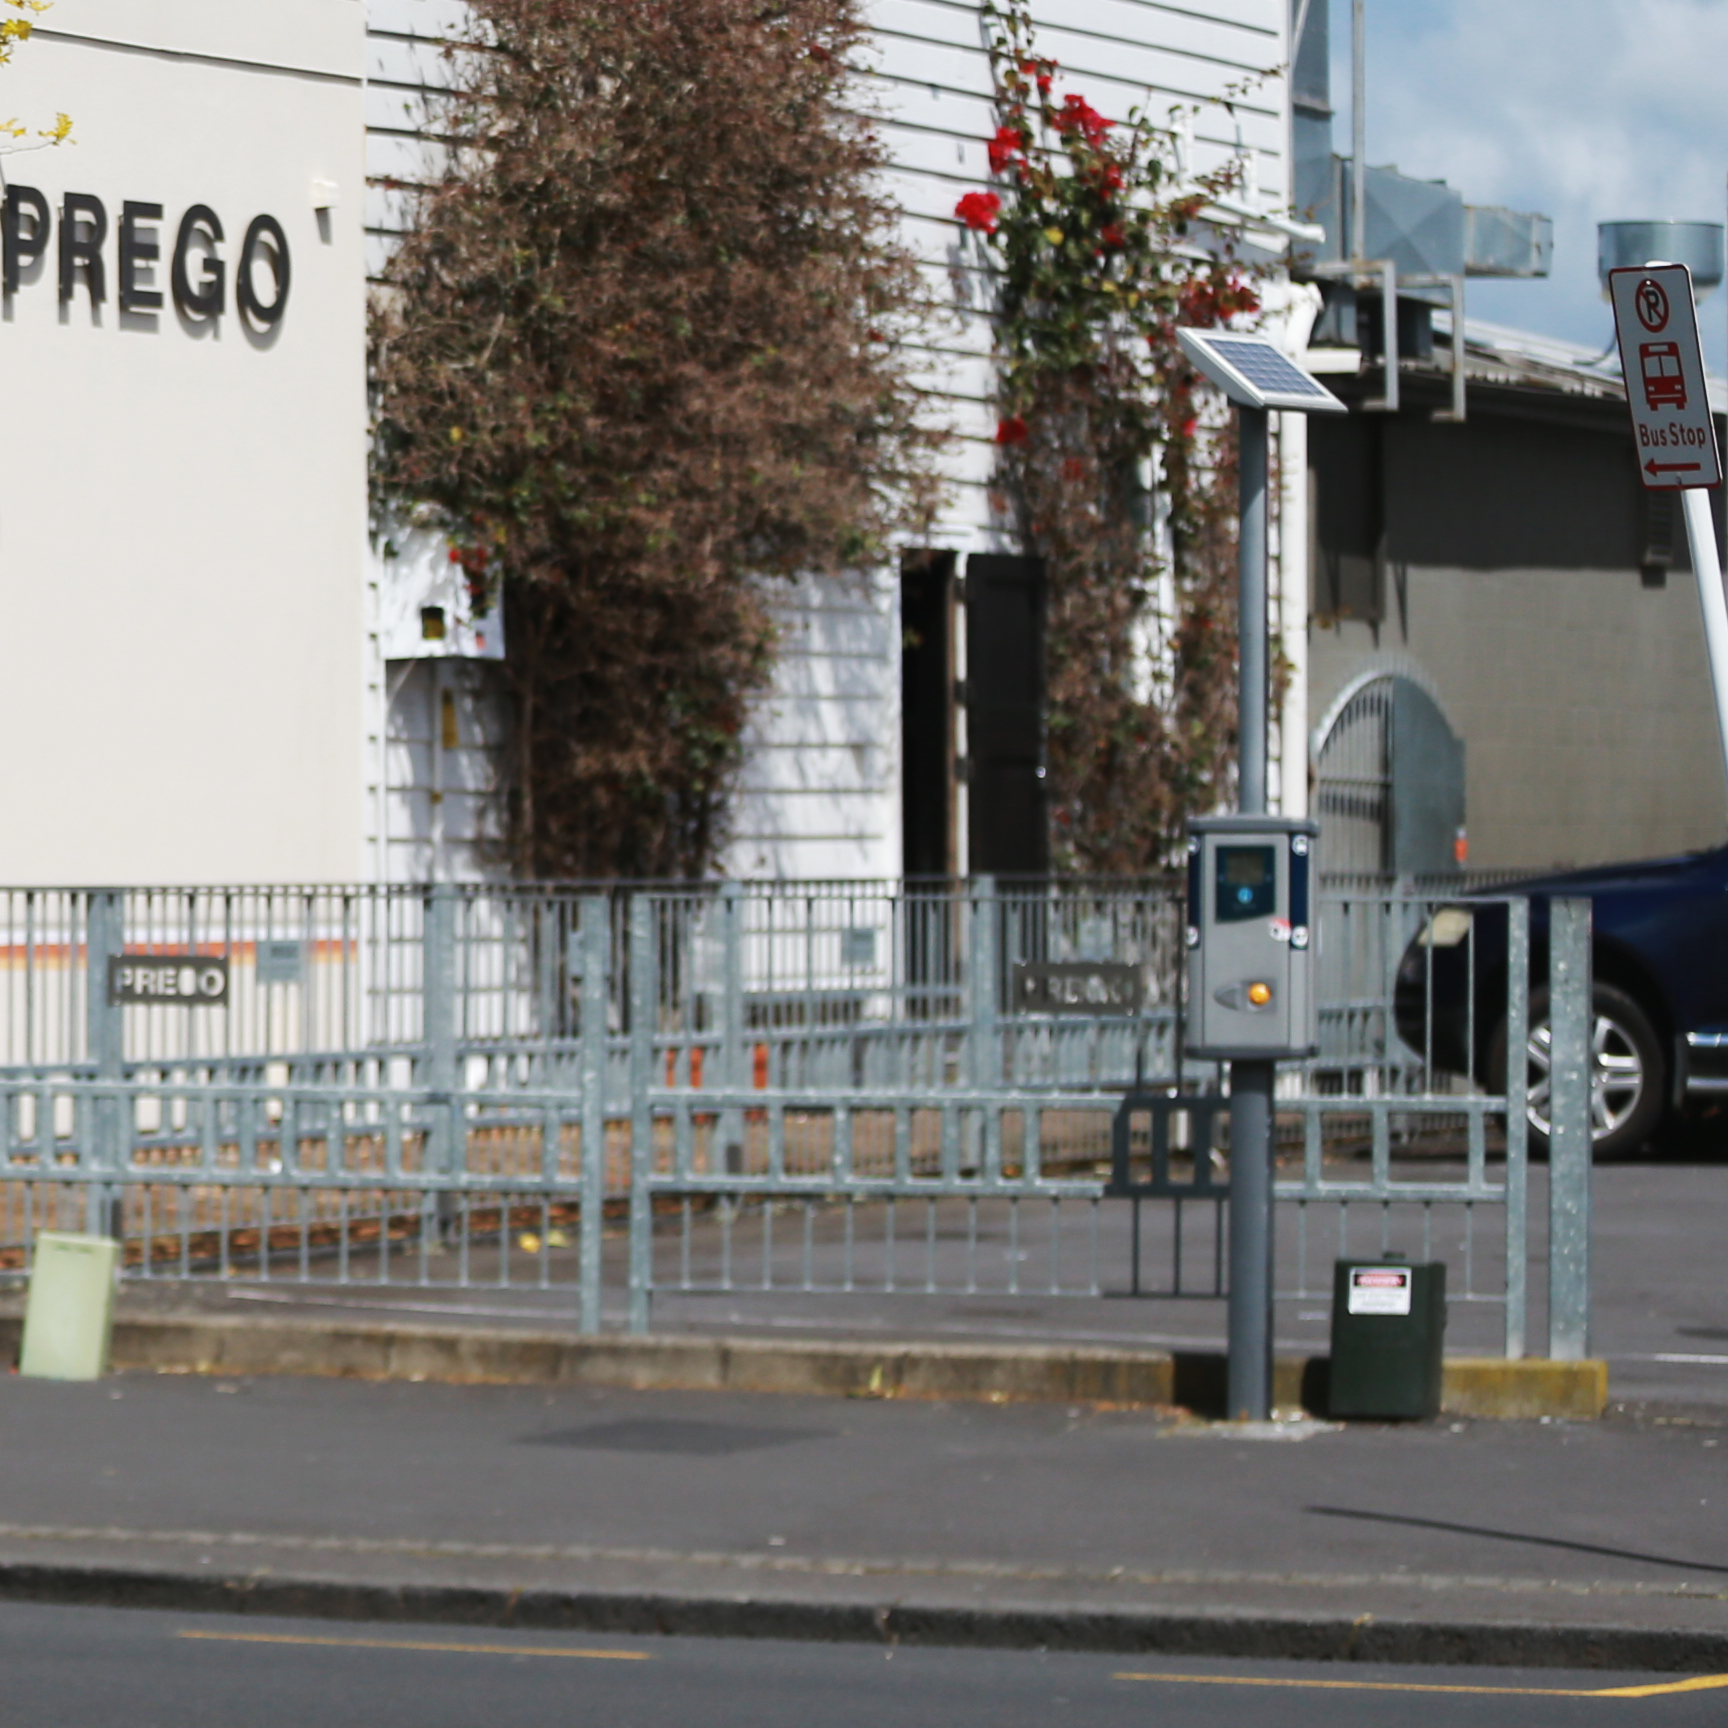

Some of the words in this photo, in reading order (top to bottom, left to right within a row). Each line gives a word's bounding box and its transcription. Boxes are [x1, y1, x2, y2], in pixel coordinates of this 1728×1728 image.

[2, 183, 292, 324] PREGO
[1638, 423, 1667, 448] Bus
[1669, 422, 1707, 449] Stop
